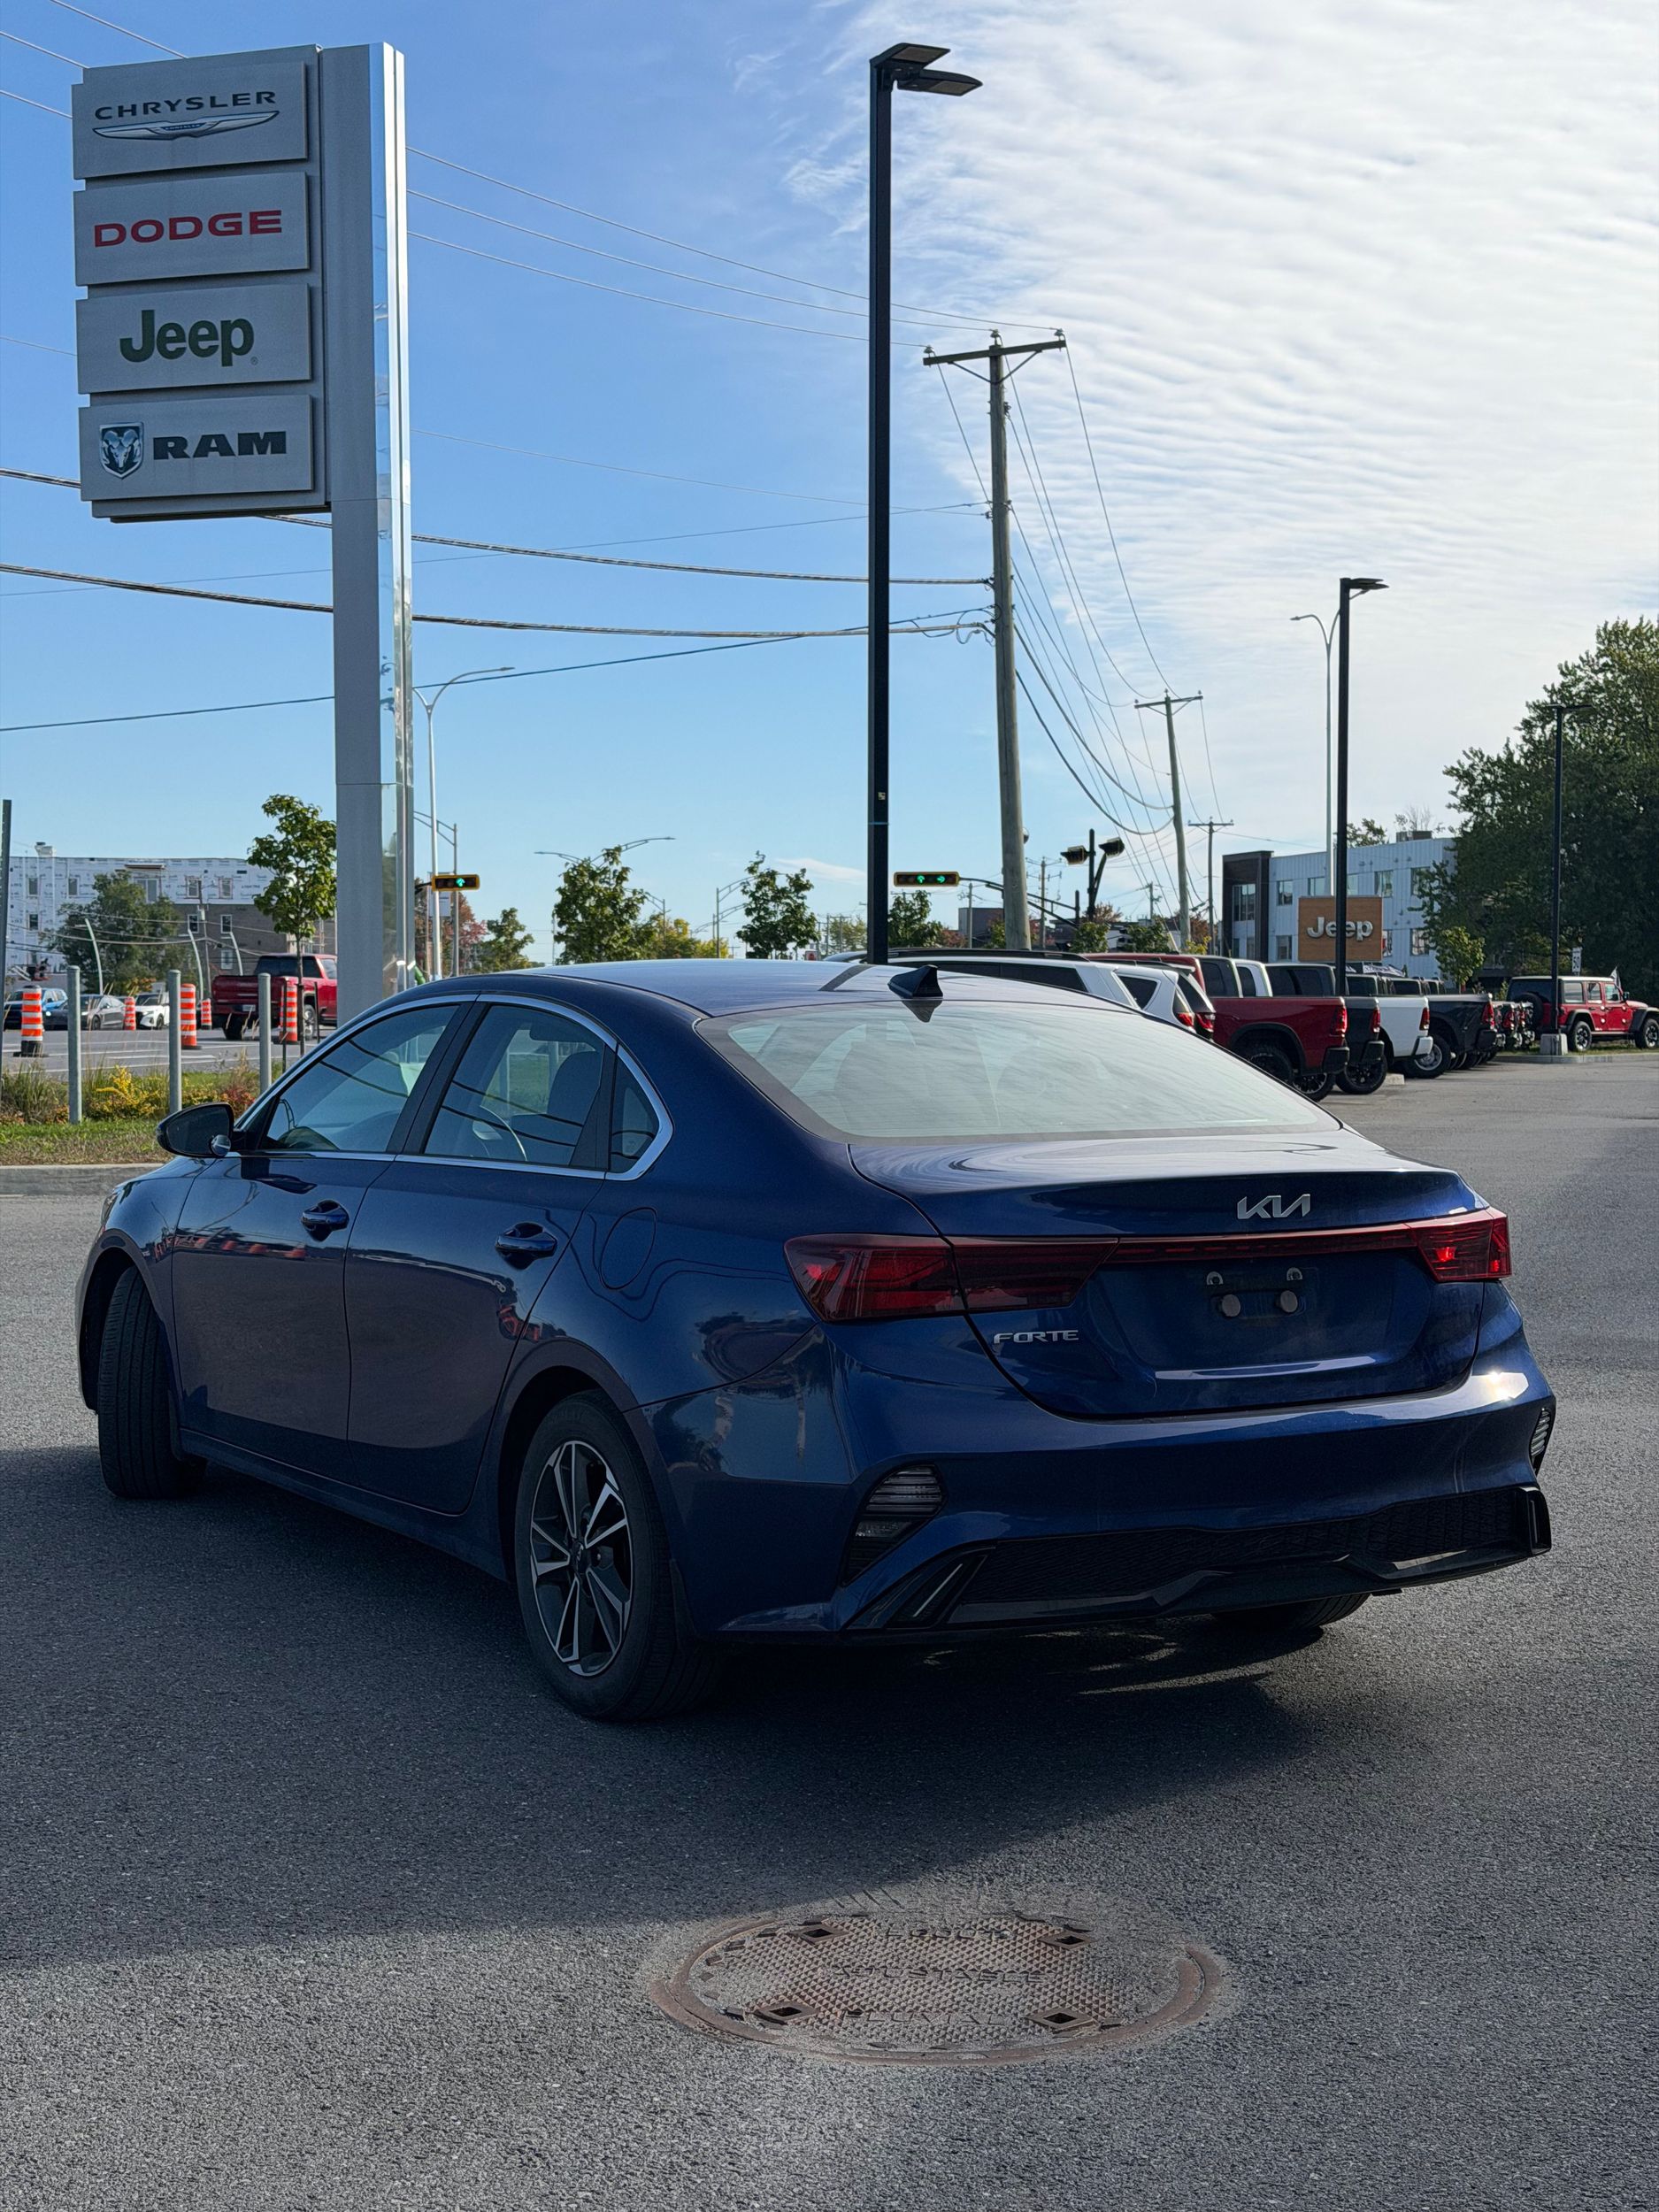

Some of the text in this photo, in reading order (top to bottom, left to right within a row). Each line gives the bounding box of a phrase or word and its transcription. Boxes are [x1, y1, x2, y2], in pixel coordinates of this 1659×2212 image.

[94, 91, 276, 120] CHRYSLER
[94, 209, 282, 248] DODGE
[119, 309, 254, 367] Jeep
[152, 430, 287, 460] RAM
[1307, 916, 1373, 942] Jeep
[1237, 1194, 1311, 1220] KIA
[994, 1329, 1079, 1344] FORTE
